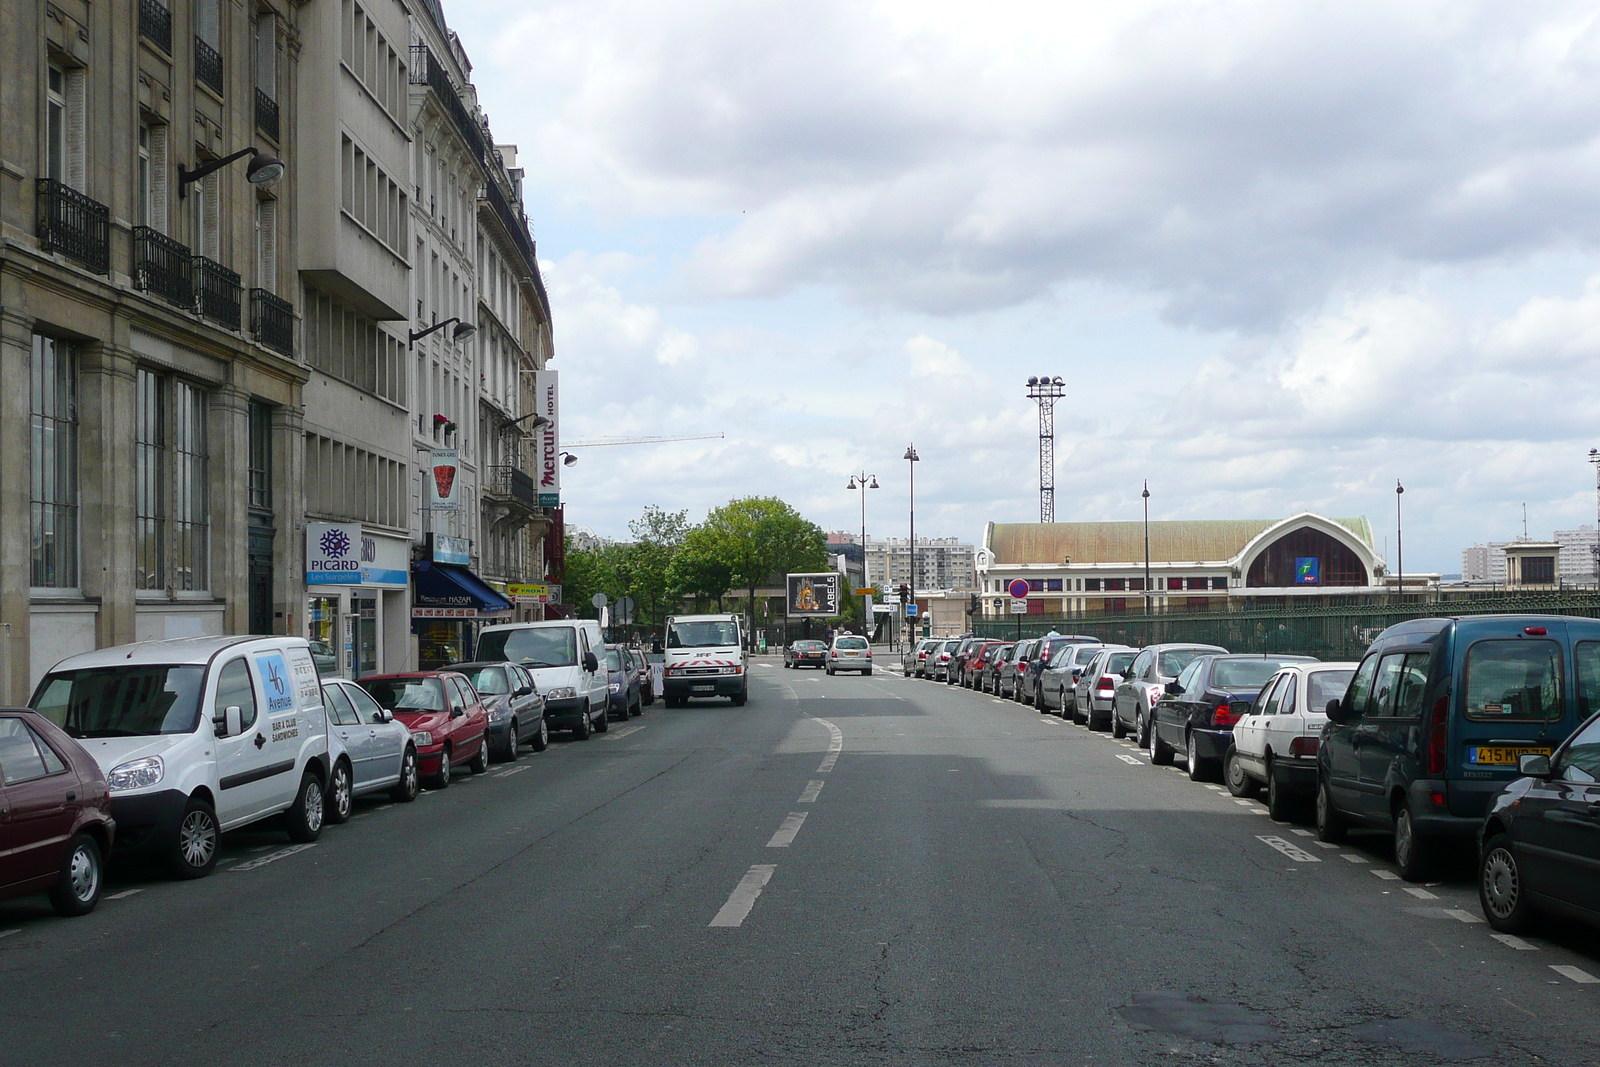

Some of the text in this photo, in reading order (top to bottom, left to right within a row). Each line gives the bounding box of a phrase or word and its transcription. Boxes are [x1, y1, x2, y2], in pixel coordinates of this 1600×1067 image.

[269, 696, 292, 711] Avenue
[272, 721, 282, 732] BAR
[286, 718, 297, 729] CLUB
[272, 728, 298, 742] SANDWICHES
[1478, 748, 1503, 762] 415
